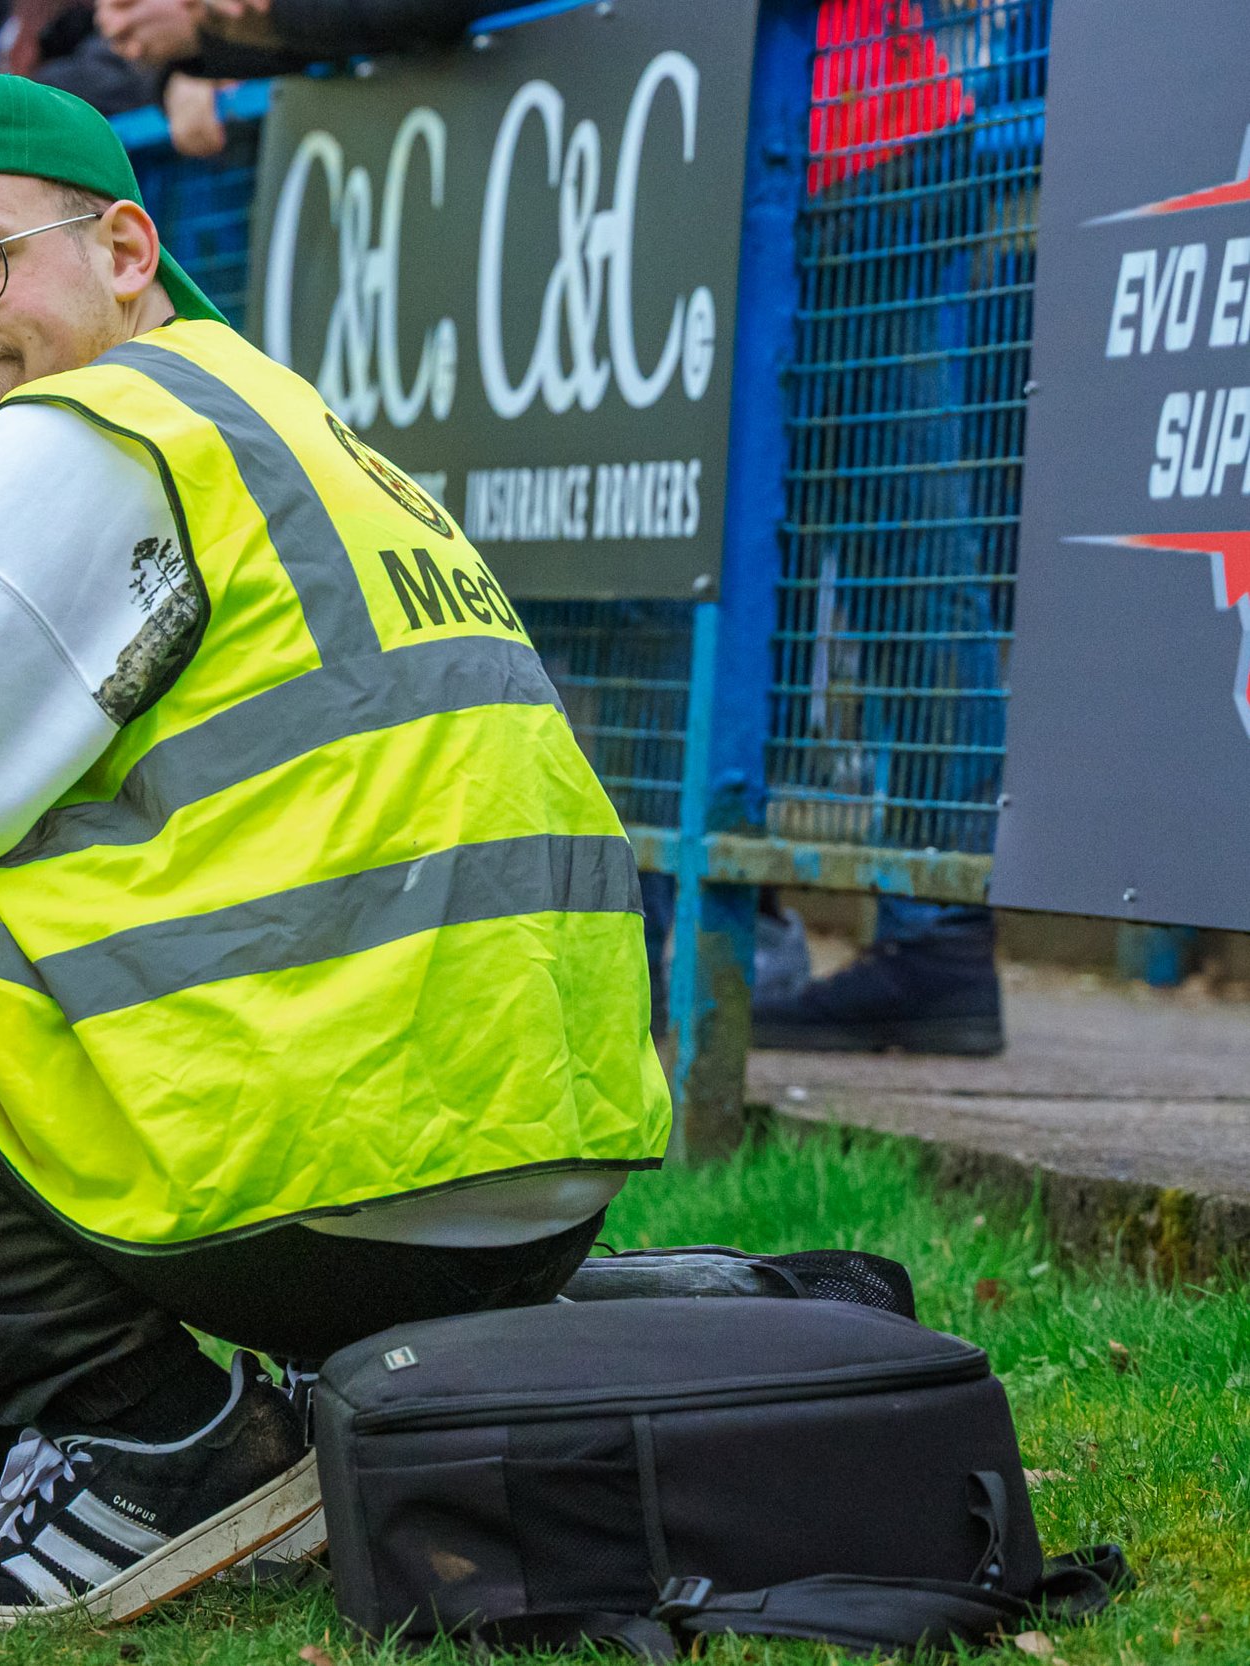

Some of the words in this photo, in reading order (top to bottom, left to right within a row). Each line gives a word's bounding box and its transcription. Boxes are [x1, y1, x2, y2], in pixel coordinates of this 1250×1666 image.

[1106, 243, 1207, 357] EVO
[1150, 387, 1250, 499] SUP
[465, 466, 591, 542] INSURANCE
[592, 459, 701, 540] BROKERS
[113, 1494, 156, 1522] CAMPUS
